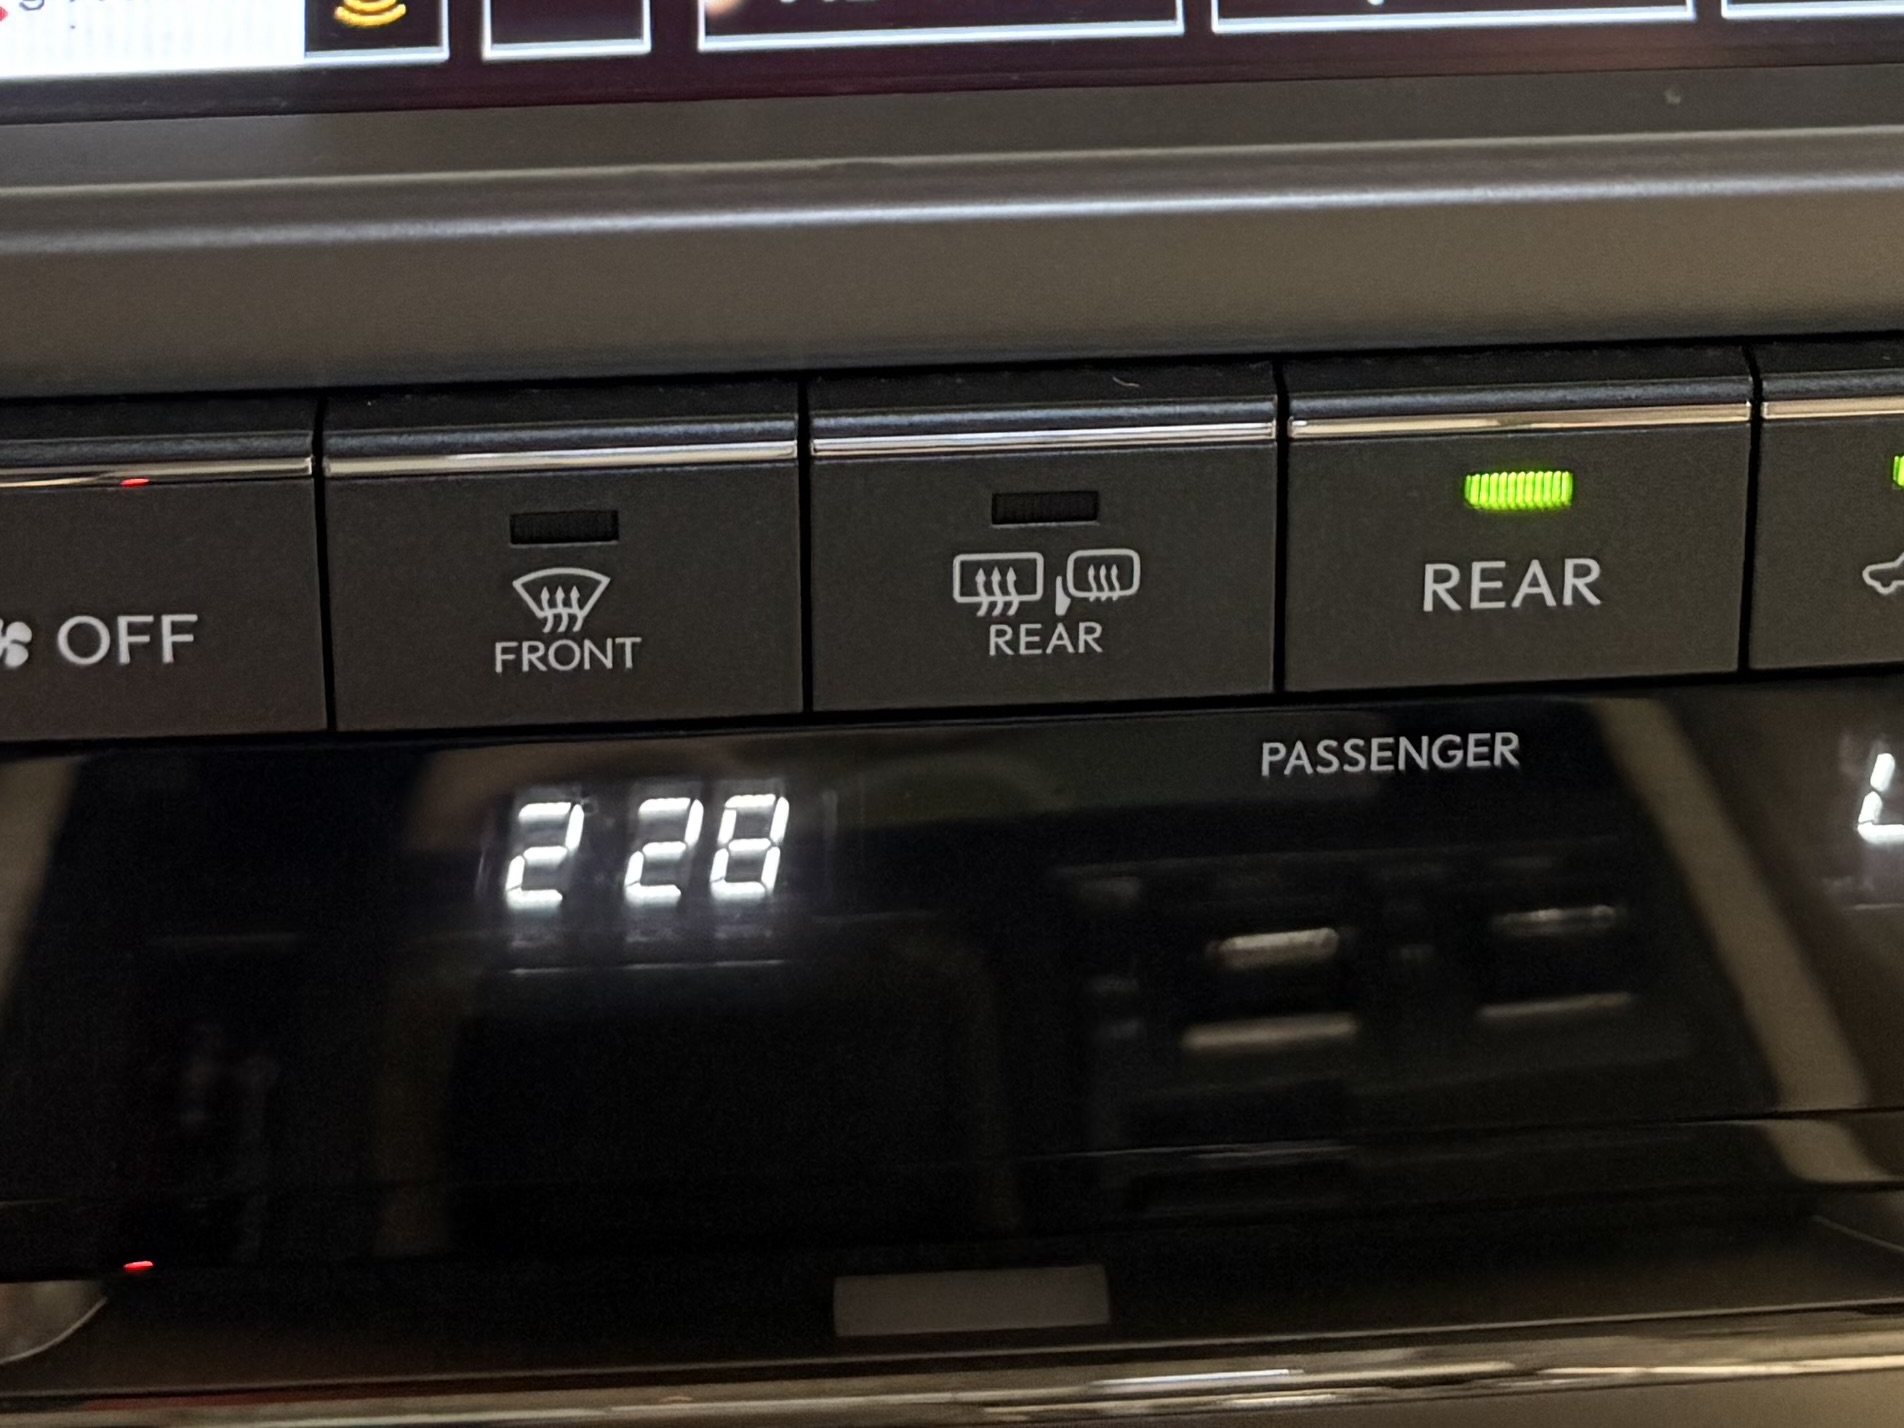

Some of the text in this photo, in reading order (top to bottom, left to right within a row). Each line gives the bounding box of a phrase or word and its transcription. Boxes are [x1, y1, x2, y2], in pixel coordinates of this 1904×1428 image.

[1422, 556, 1602, 613] REAR
[55, 612, 199, 667] OFF
[493, 635, 642, 675] FRONT
[987, 620, 1104, 658] REAR
[1259, 730, 1520, 779] PASSENGER
